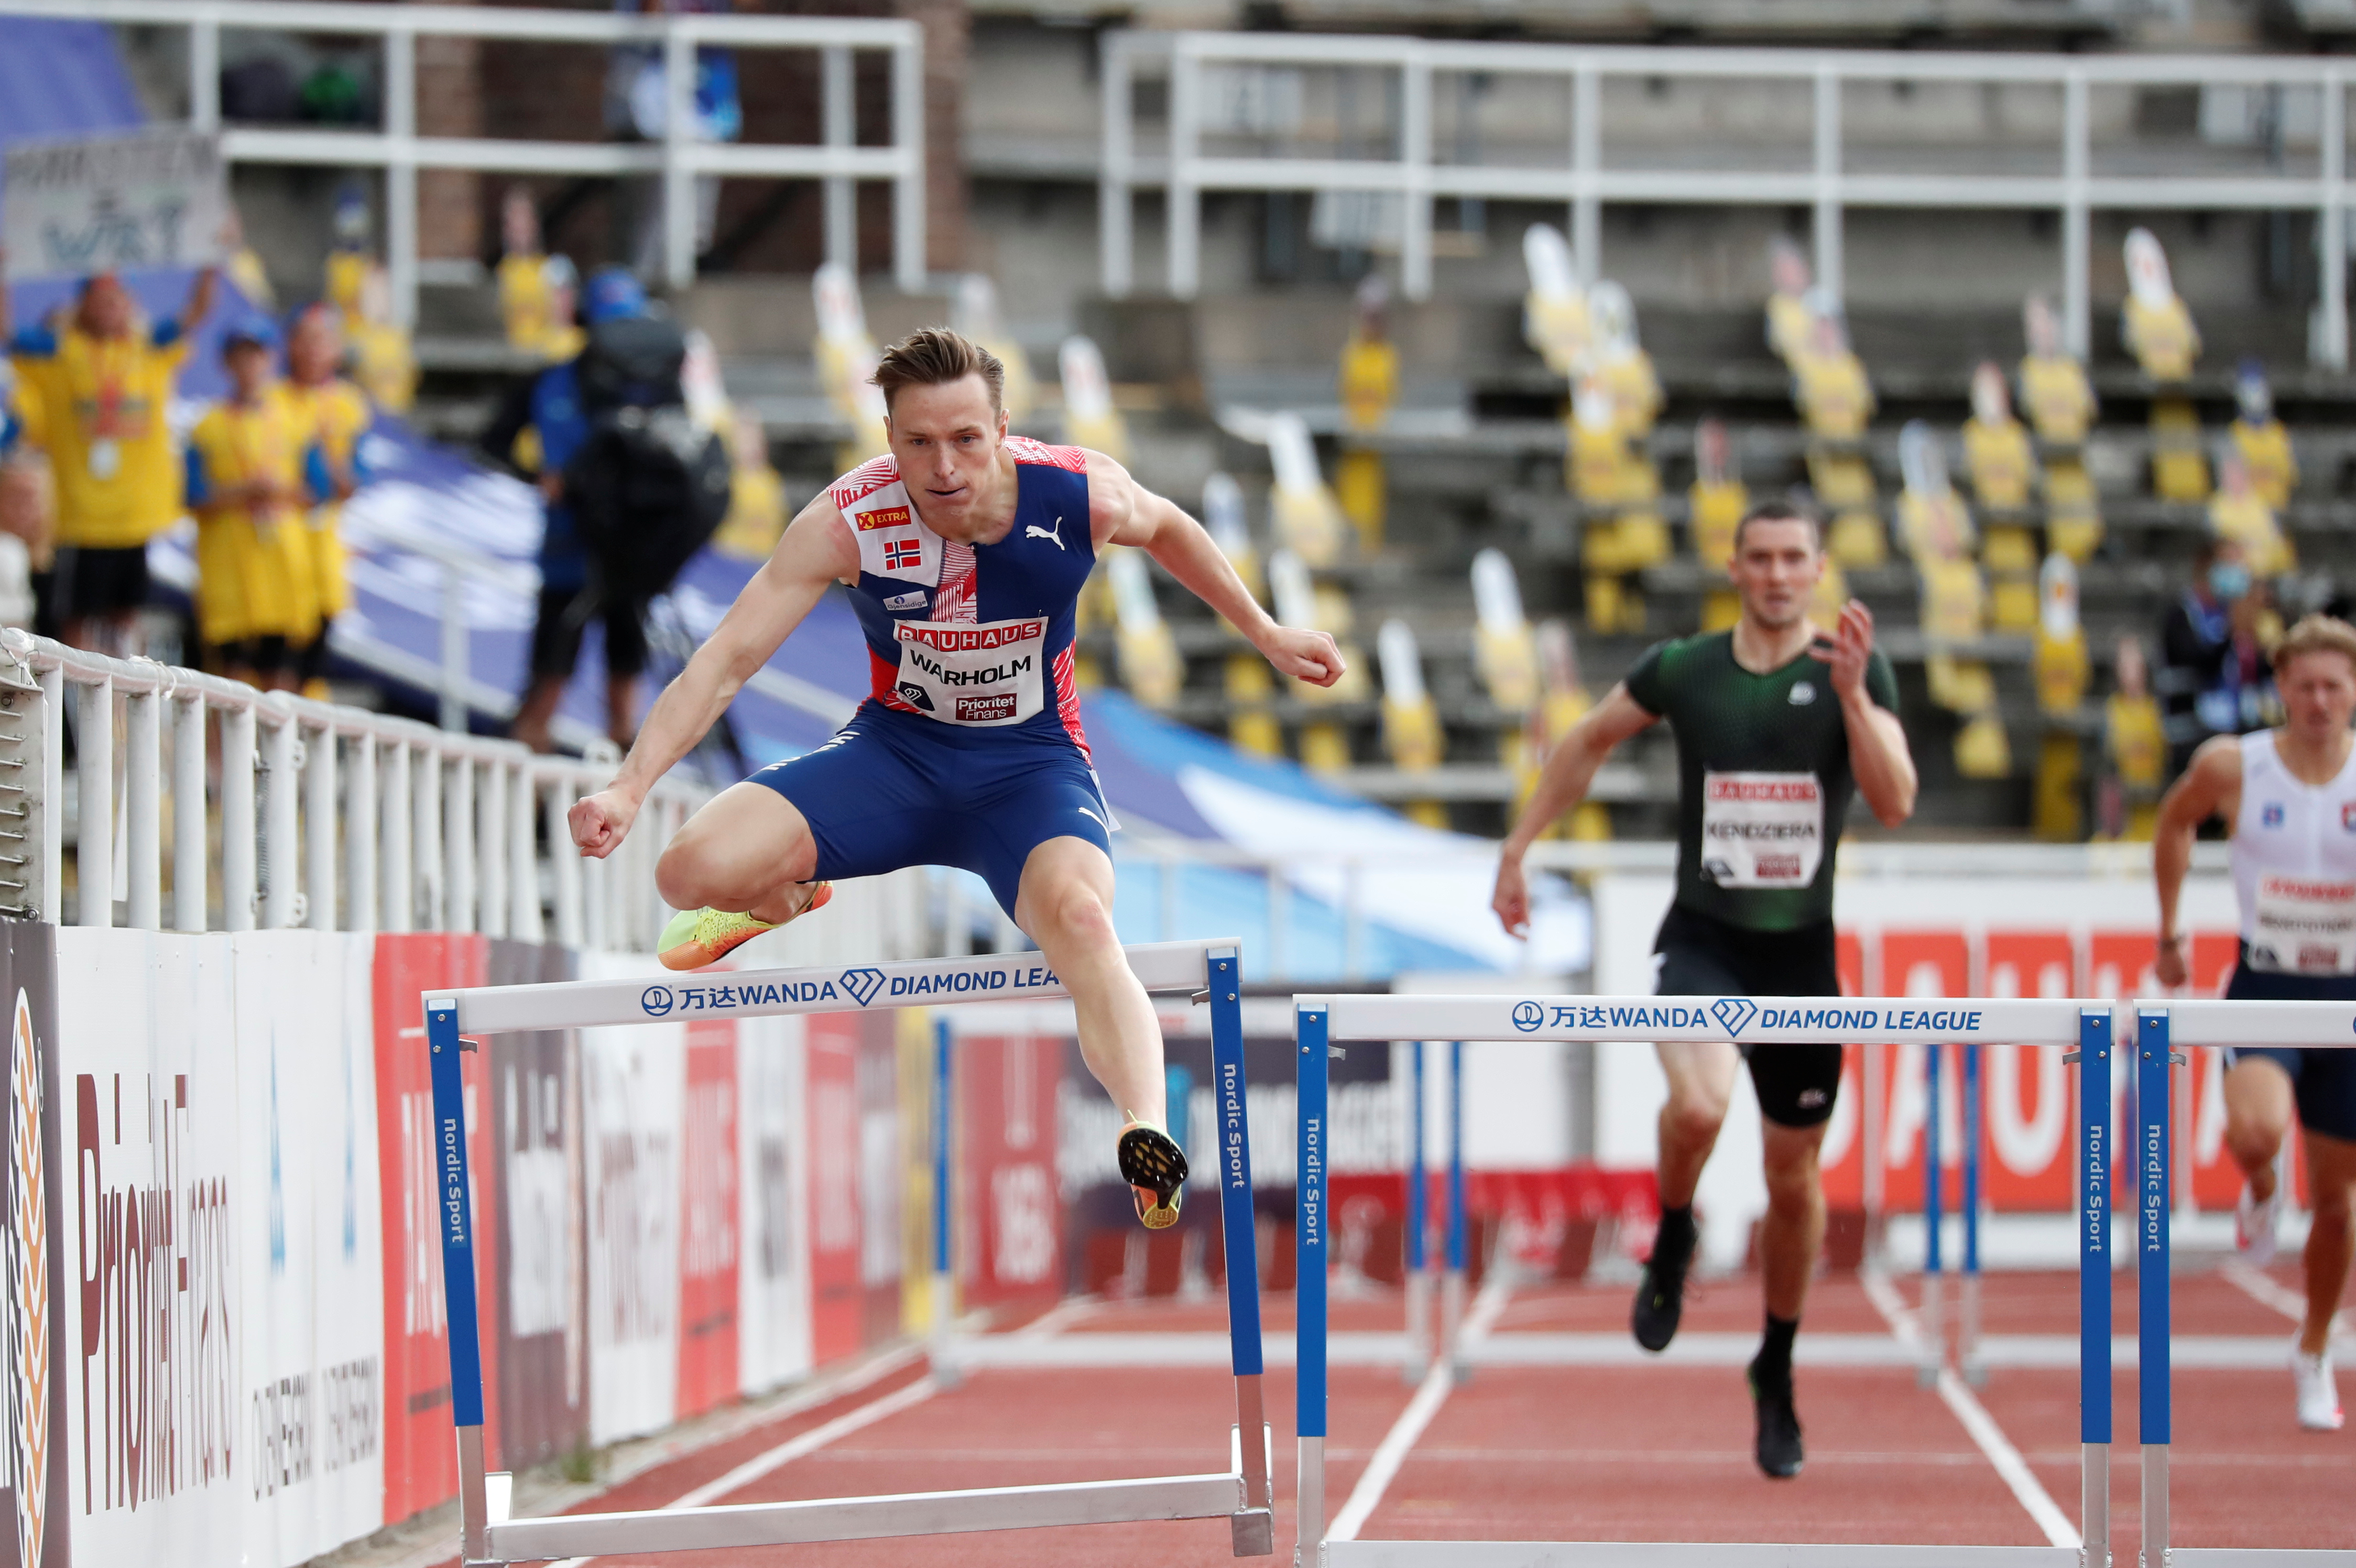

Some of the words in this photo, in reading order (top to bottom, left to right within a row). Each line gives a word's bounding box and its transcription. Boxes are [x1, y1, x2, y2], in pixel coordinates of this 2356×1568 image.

[877, 511, 909, 524] EXTRA
[887, 601, 926, 609] Gjensidige
[900, 624, 1038, 649] BAUHAUS
[910, 654, 1031, 686] WARHOLM
[958, 695, 1015, 711] Prioritet
[965, 709, 1007, 720] Finans
[1705, 821, 1816, 840] KENDZIERA
[738, 981, 838, 1005] WANDA
[890, 971, 1007, 996] DIAMOND
[1013, 968, 1060, 988] LEA
[1609, 1007, 1709, 1028] WANDA
[1760, 1009, 1879, 1029] DIAMOND
[1884, 1011, 1982, 1030] LEAGUE
